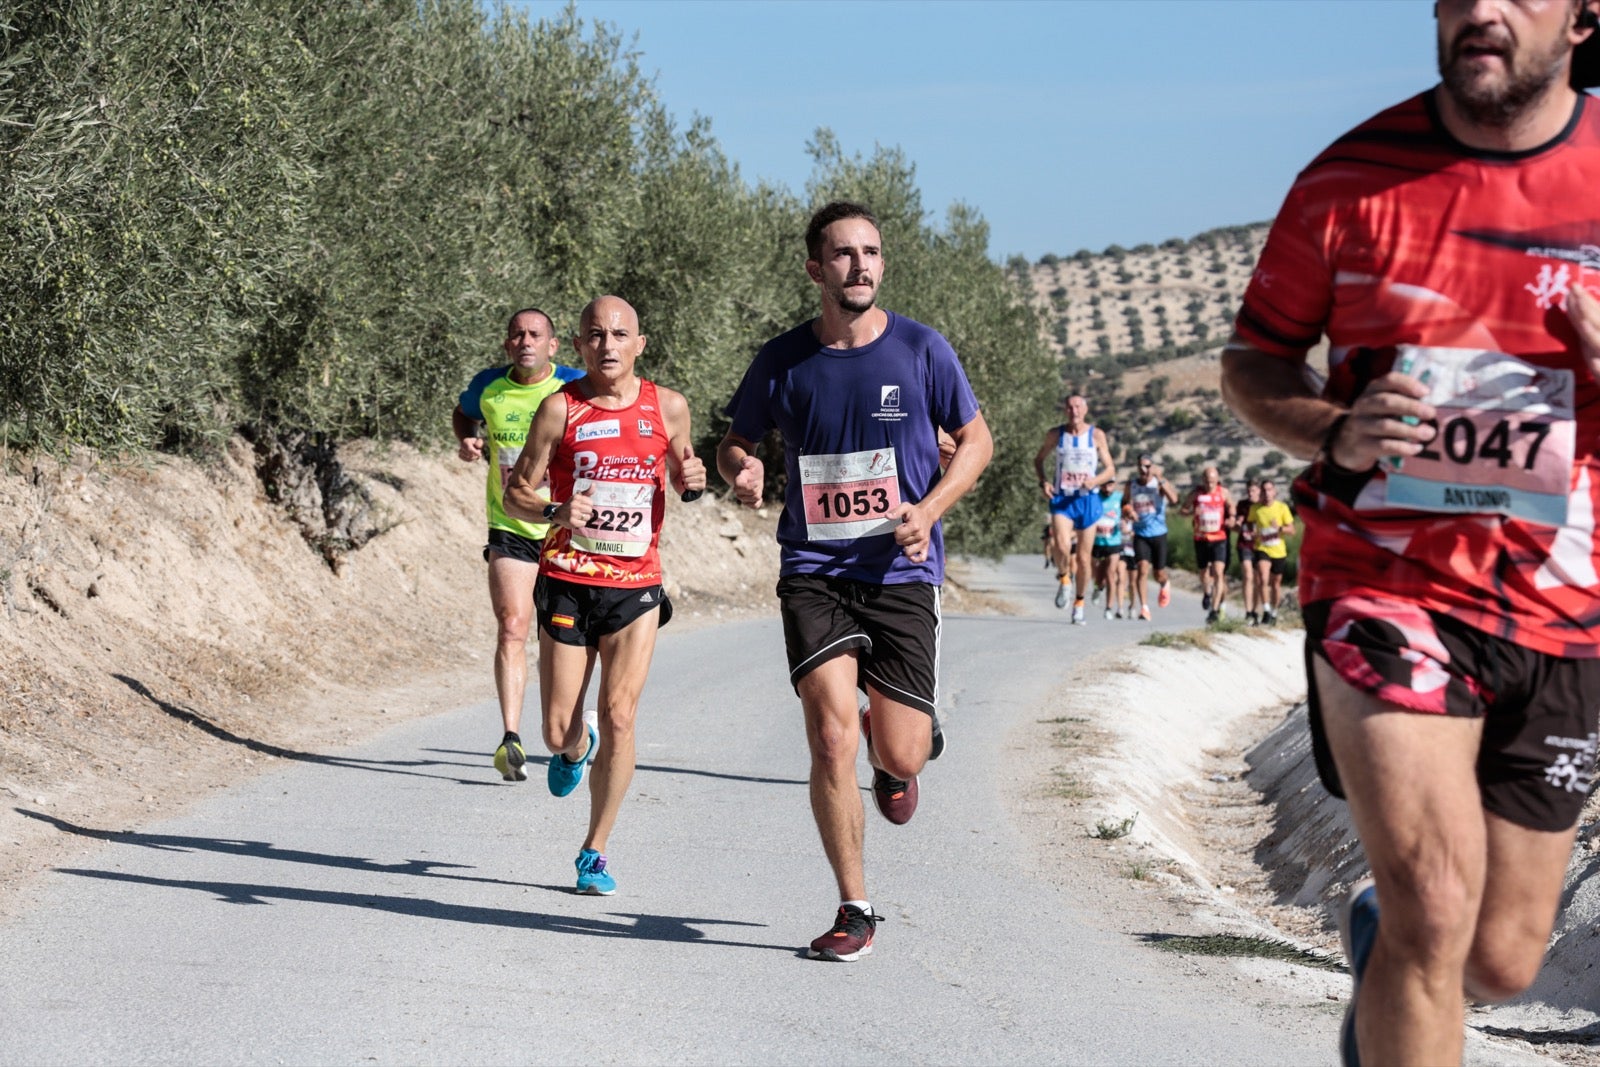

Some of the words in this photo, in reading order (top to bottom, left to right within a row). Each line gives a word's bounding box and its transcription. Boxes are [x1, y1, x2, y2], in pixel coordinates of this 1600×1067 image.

[1415, 415, 1550, 470] 2047
[817, 488, 889, 519] 1053
[1443, 487, 1511, 508] ANTONIO
[585, 508, 643, 532] 2222
[595, 541, 624, 553] MANUEL
